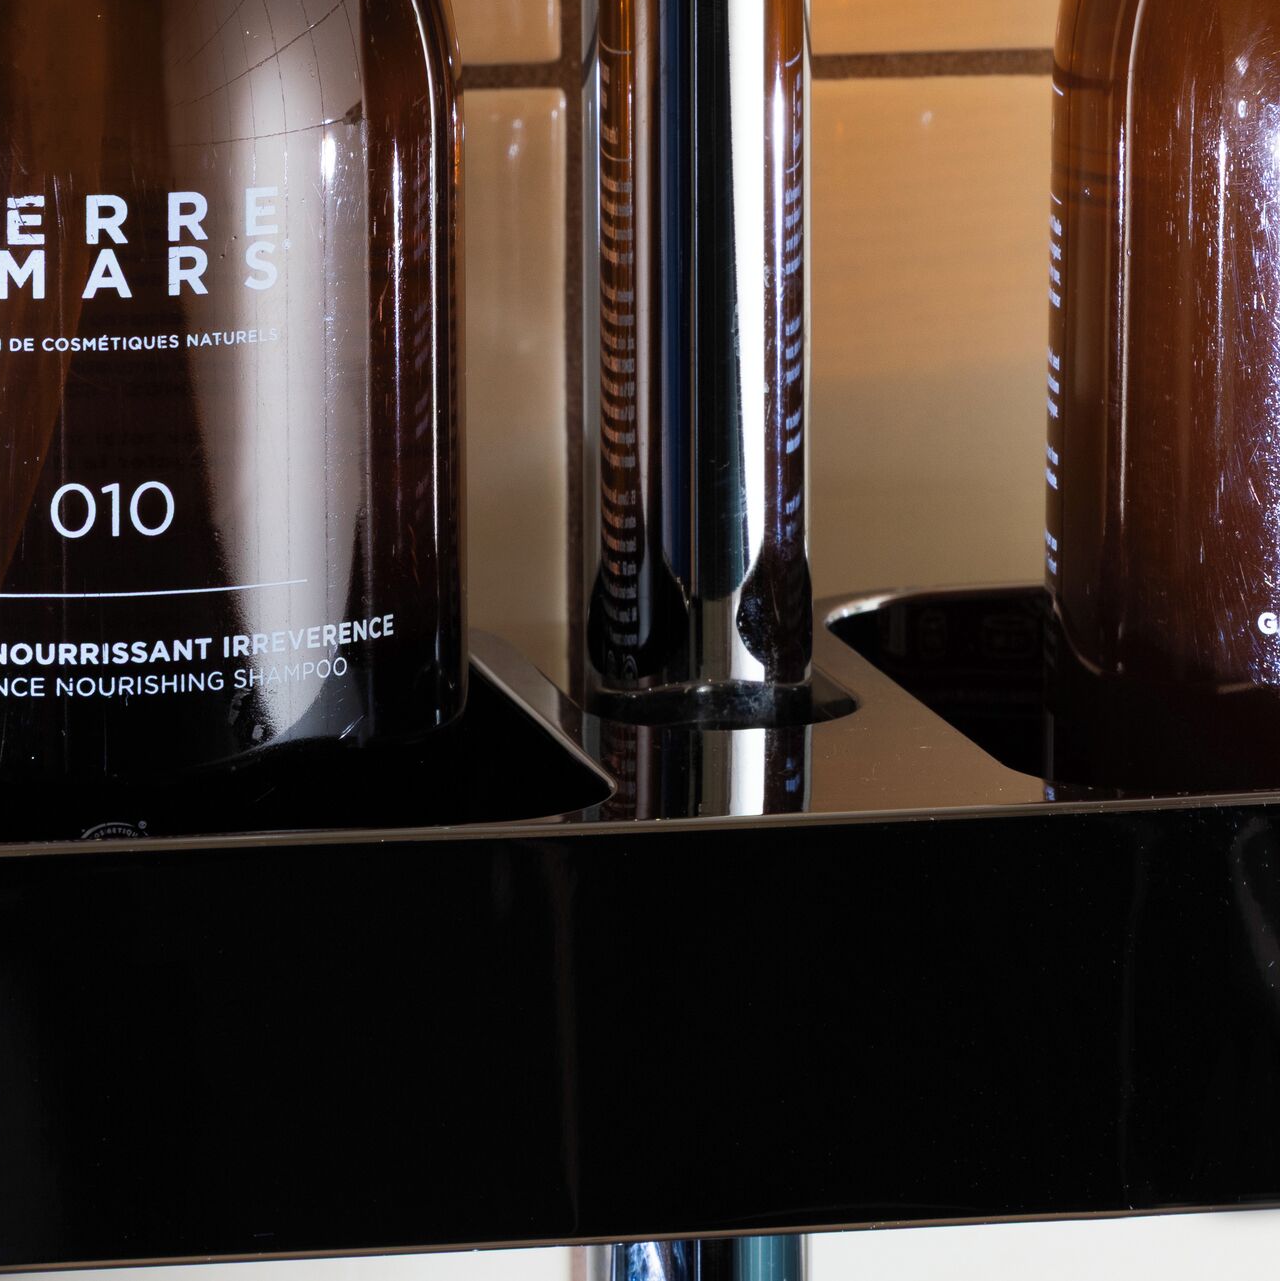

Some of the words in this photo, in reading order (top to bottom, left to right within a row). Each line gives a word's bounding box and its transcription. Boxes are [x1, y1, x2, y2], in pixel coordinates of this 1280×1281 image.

[9, 338, 34, 352] DE
[42, 334, 179, 352] COSMÉTIQUES
[186, 328, 278, 348] NATURELS
[50, 480, 175, 539] 010
[223, 614, 394, 658] IRREVERENCE
[56, 671, 224, 697] NOURISHING
[233, 656, 348, 689] SHAMPOO
